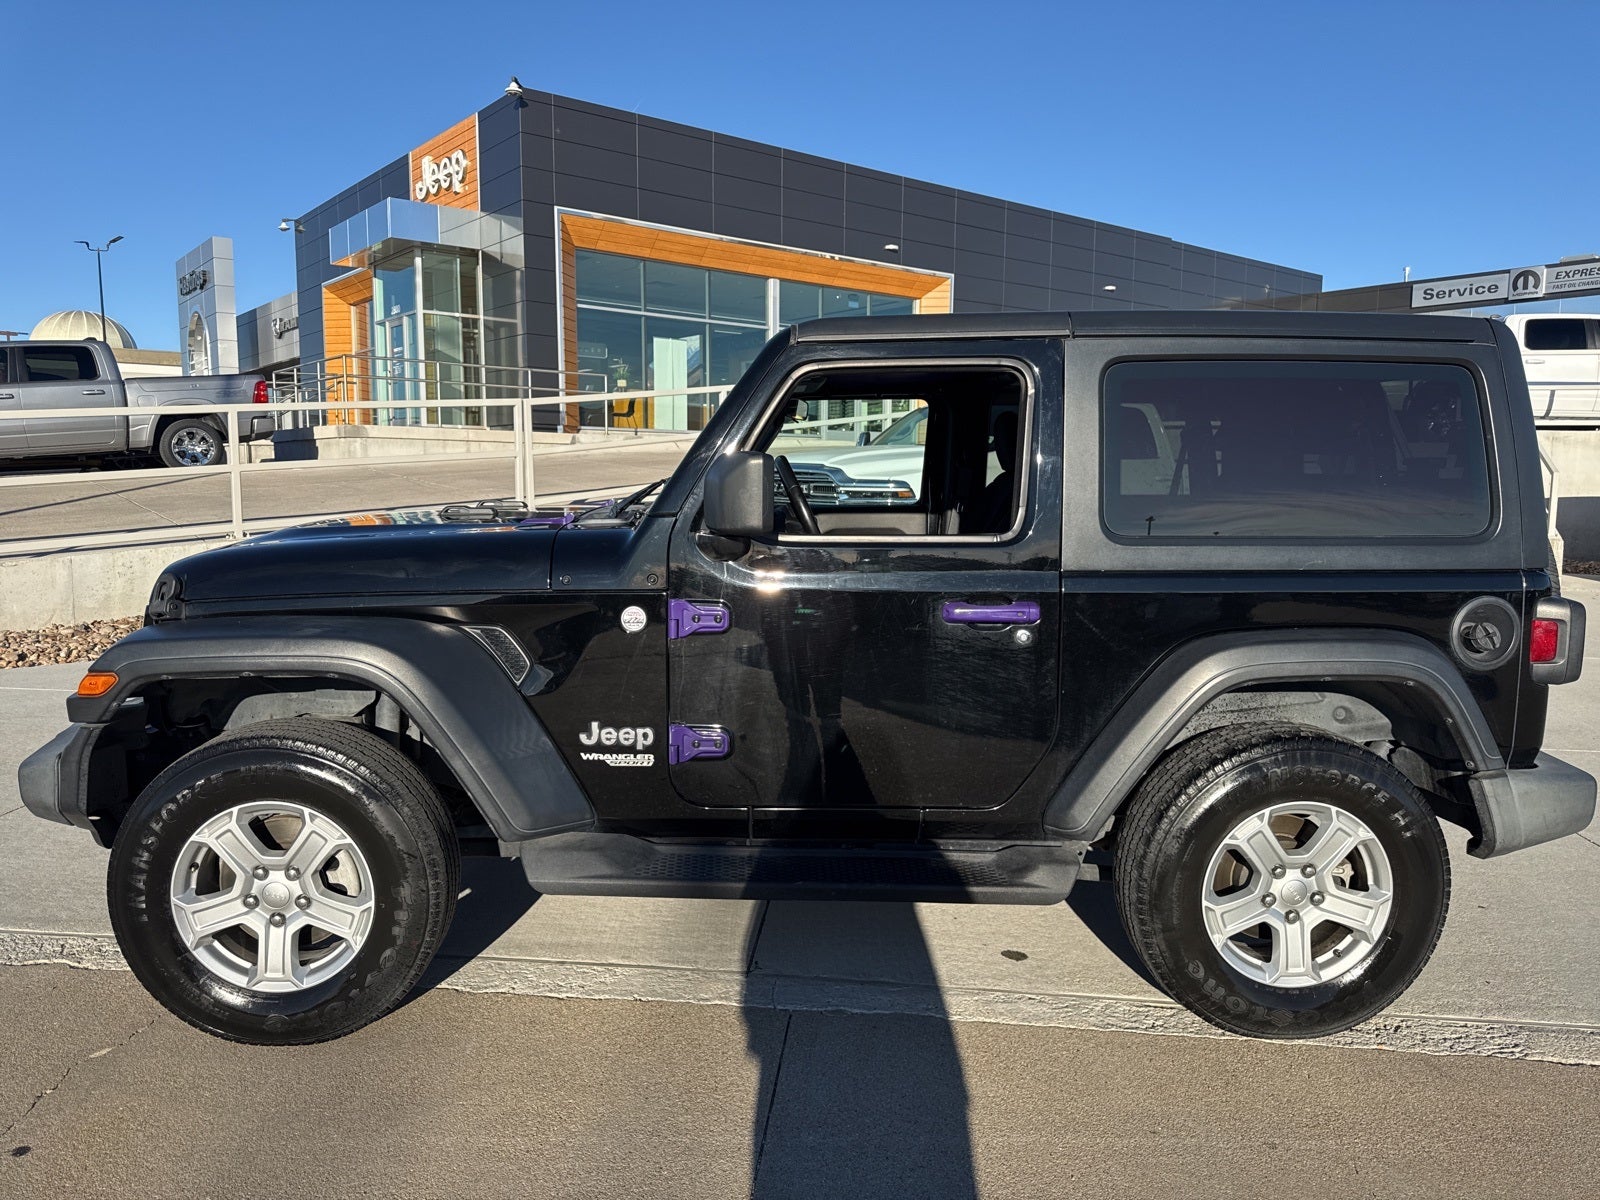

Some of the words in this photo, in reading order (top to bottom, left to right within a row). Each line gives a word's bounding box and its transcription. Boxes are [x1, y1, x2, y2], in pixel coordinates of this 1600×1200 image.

[415, 149, 468, 200] Jeep
[1422, 283, 1499, 301] Service
[578, 721, 655, 750] Jeep
[579, 752, 655, 761] WRANGLER
